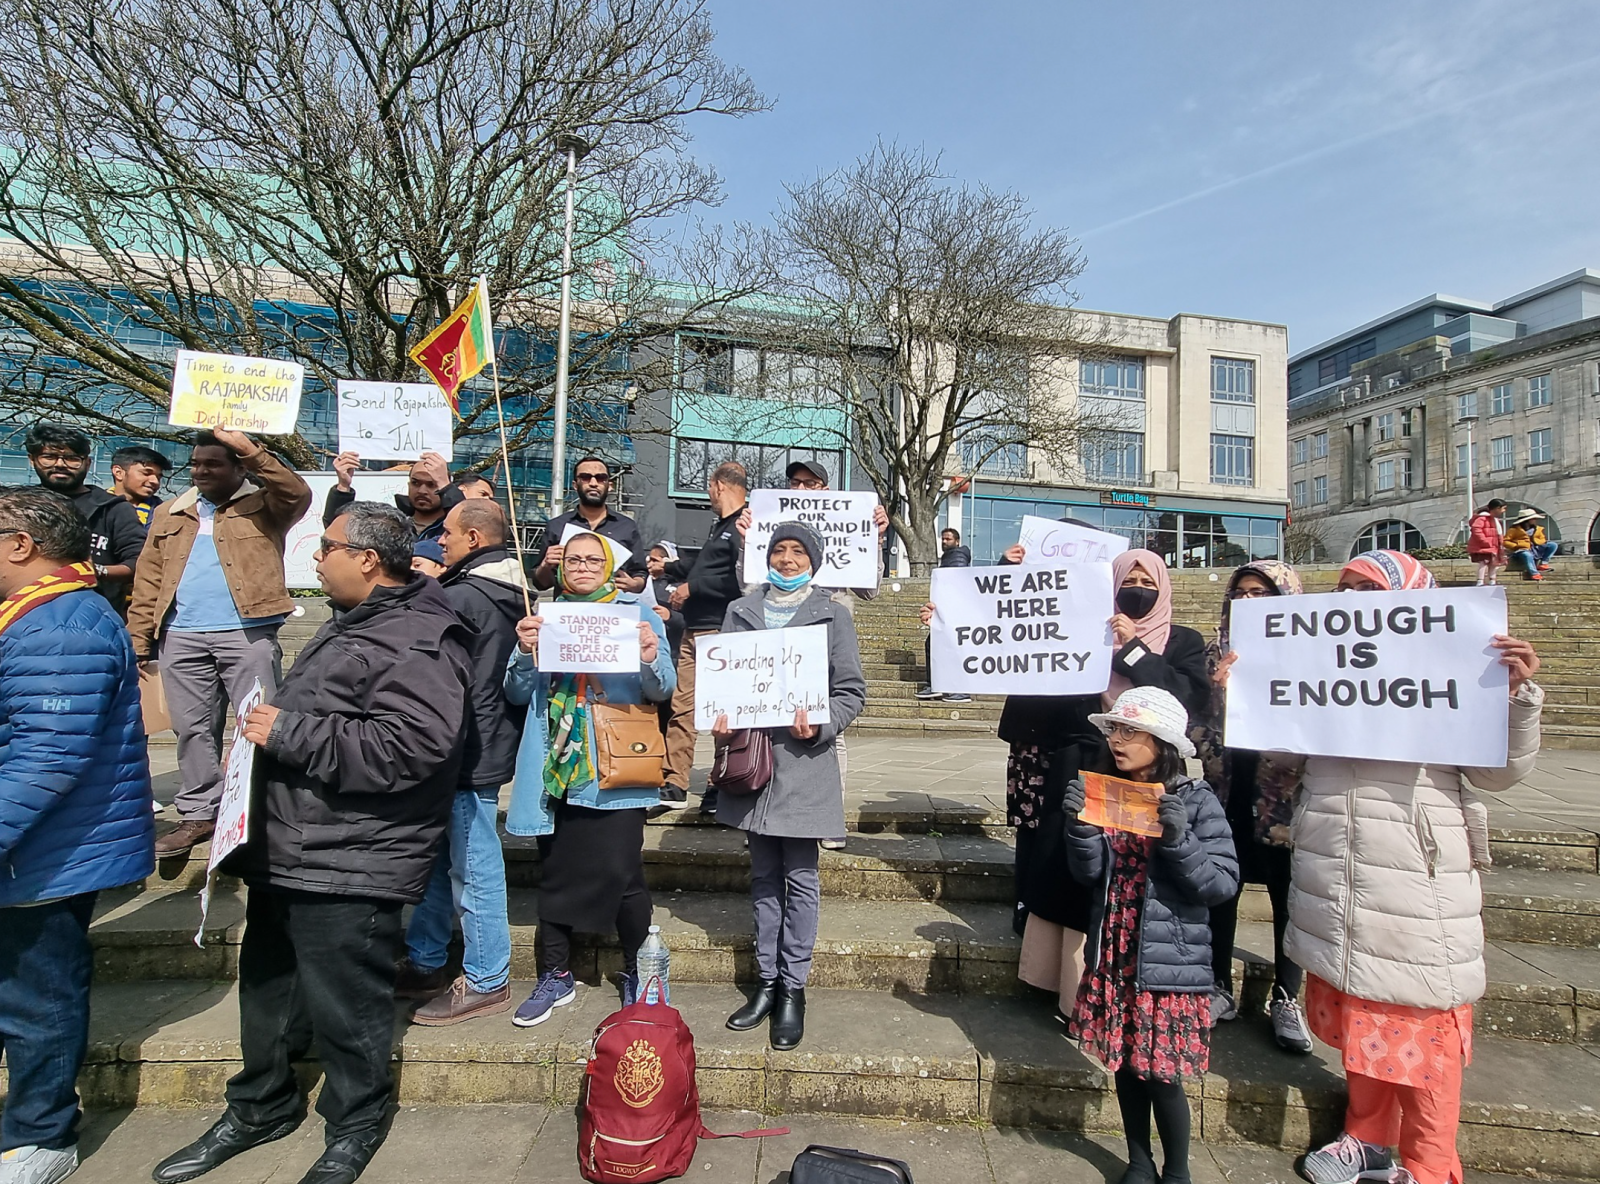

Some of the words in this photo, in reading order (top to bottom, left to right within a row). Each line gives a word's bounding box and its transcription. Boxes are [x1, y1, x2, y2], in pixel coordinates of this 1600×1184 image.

[184, 358, 215, 372] Time
[222, 361, 235, 374] to
[243, 365, 267, 378] end
[275, 367, 297, 382] the
[199, 379, 288, 403] RAJAPAKSHA
[341, 389, 386, 409] Send
[192, 410, 269, 432] Dictatorship
[356, 421, 373, 439] to
[387, 422, 432, 451] JAIL
[778, 497, 852, 513] PROTECT
[1111, 491, 1134, 503] Turtle
[1134, 493, 1150, 506] Bay
[797, 512, 827, 521] OUR
[974, 574, 1012, 594] WE
[1021, 569, 1068, 593] ARE
[997, 597, 1061, 619] HERE
[559, 615, 620, 626] STANDING
[569, 624, 585, 634] UP
[587, 625, 611, 635] FOR
[1265, 604, 1456, 638] ENOUGH
[578, 634, 601, 644] THE
[955, 625, 1003, 646] FOR
[1011, 621, 1069, 642] OUR
[559, 643, 601, 653] PEOPLE
[603, 644, 620, 654] OF
[559, 653, 576, 662] SRI
[579, 653, 619, 663] LANKA
[1336, 641, 1379, 669] IS
[704, 643, 774, 677] Standing
[781, 645, 802, 679] Up
[963, 651, 1092, 675] COUNTRY
[751, 673, 773, 694] for
[1269, 677, 1459, 710] ENOUGH
[702, 700, 726, 718] the
[736, 698, 767, 726] people
[772, 699, 783, 718] of
